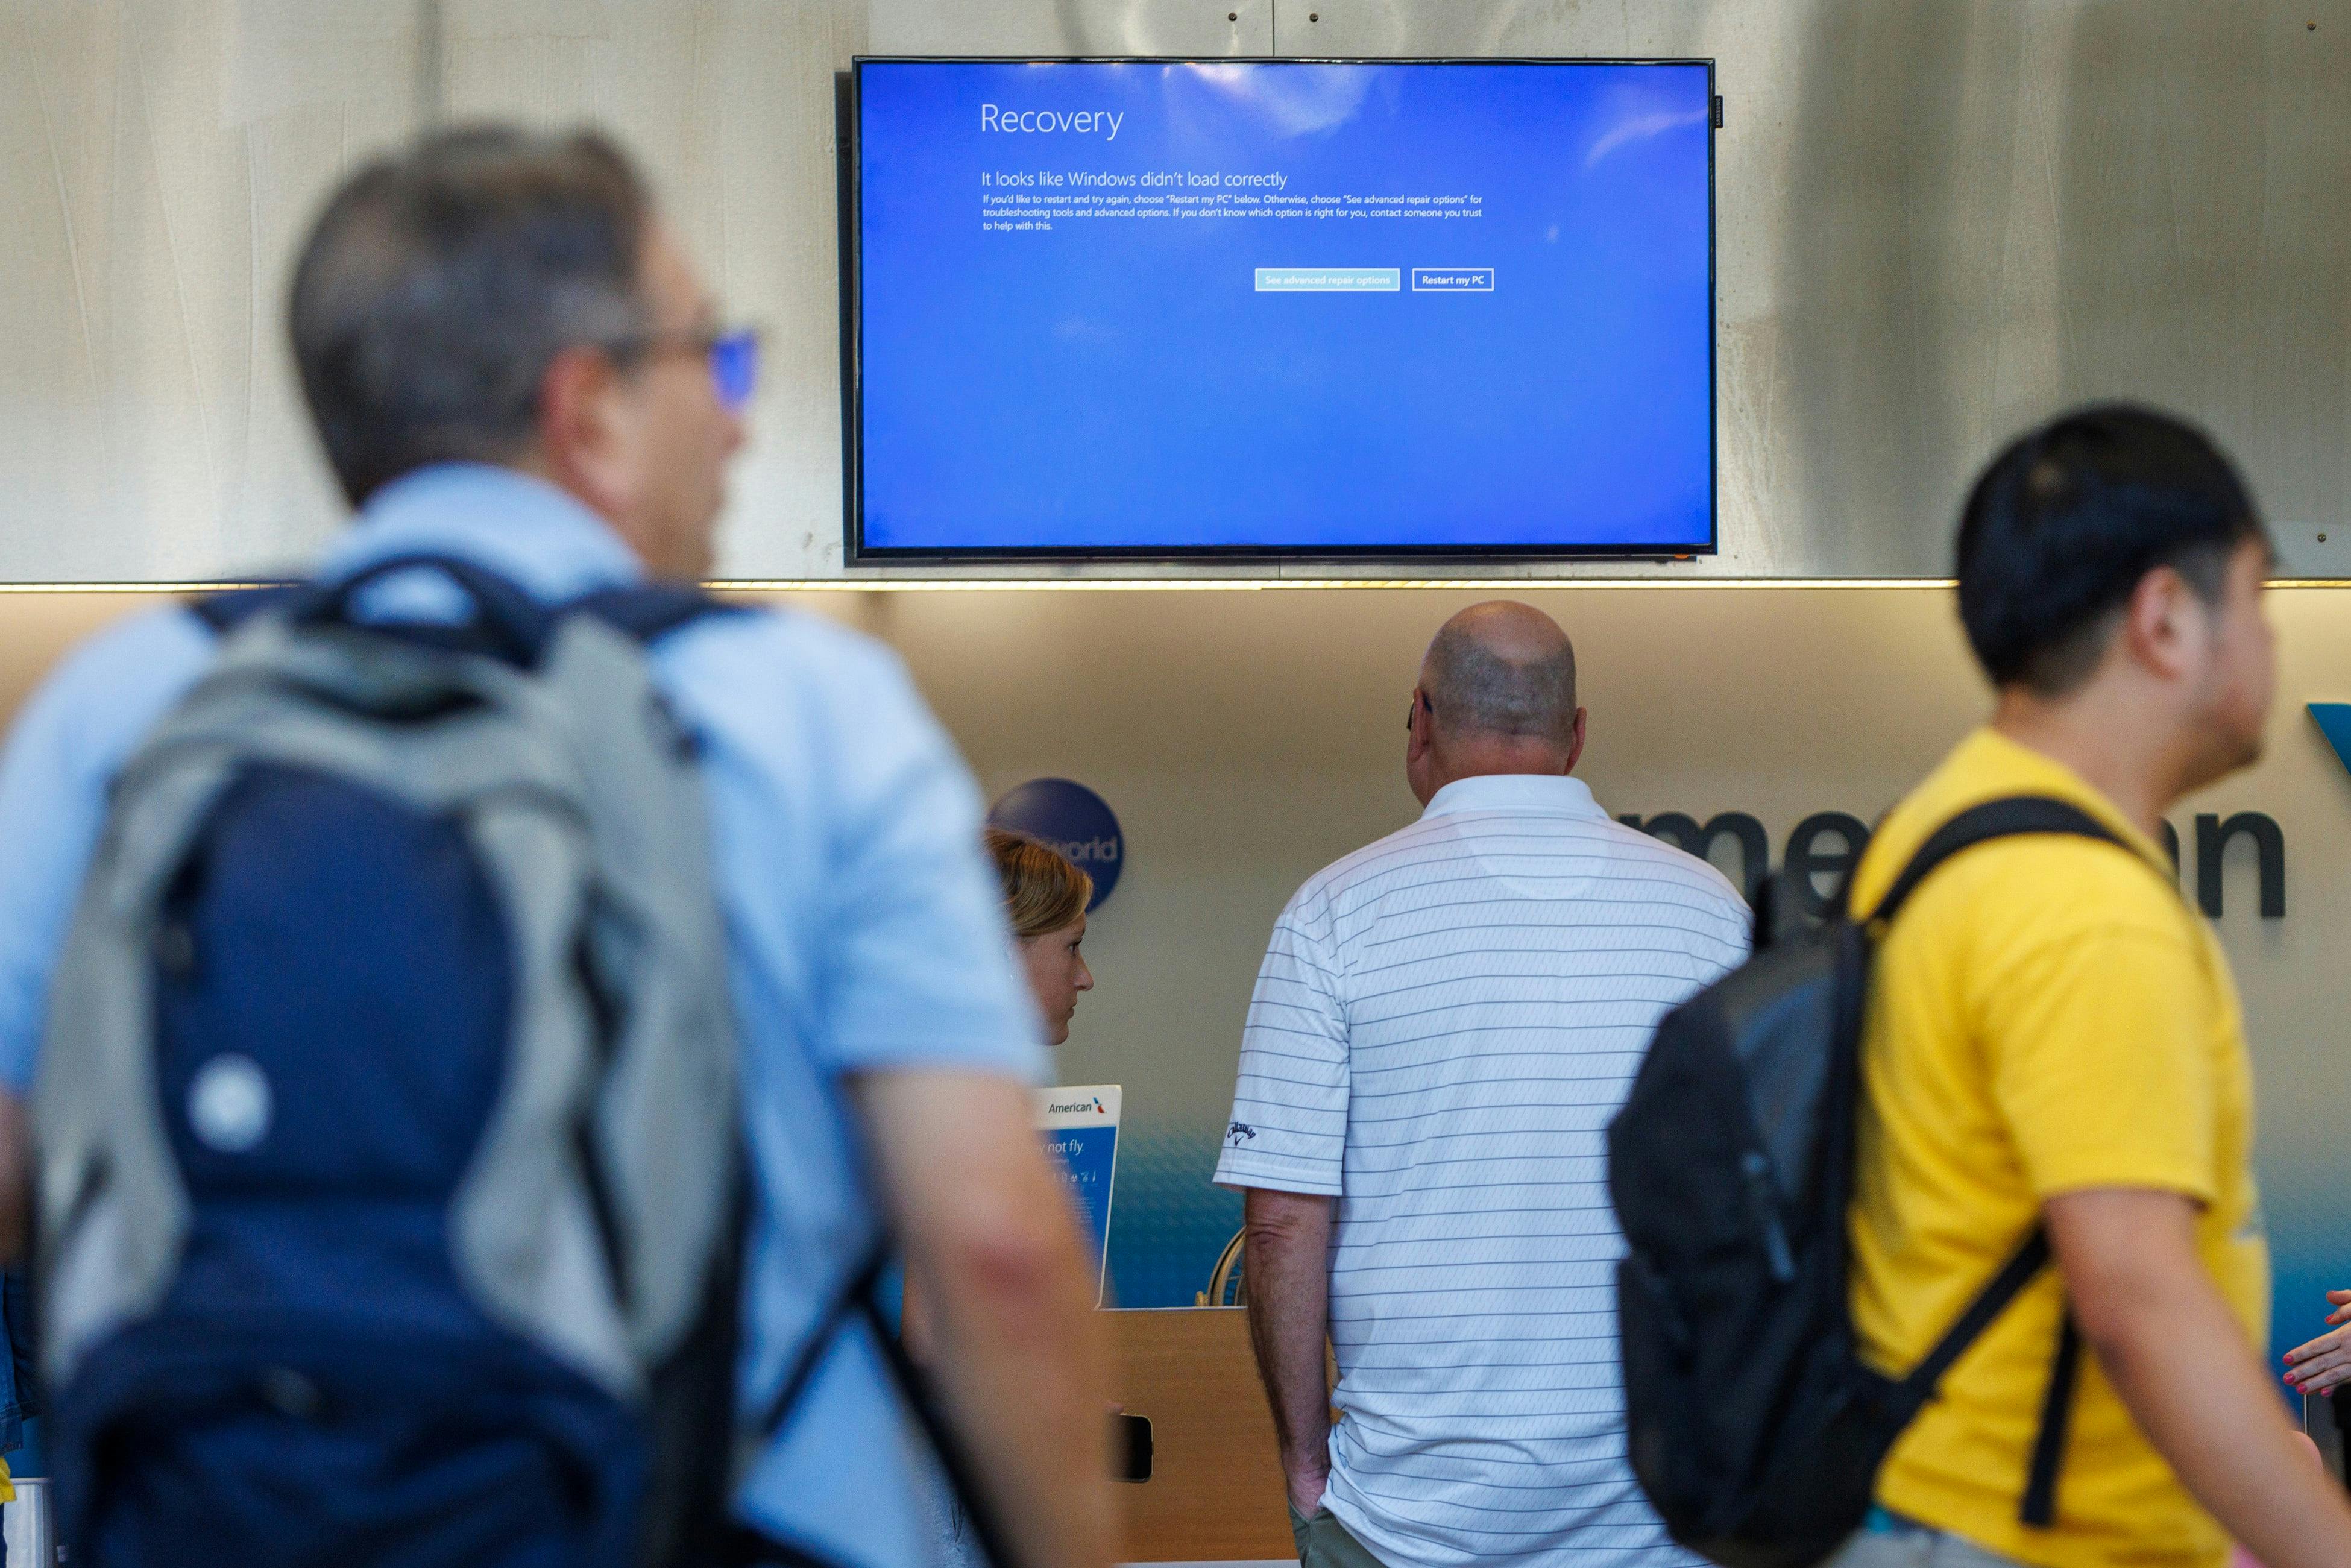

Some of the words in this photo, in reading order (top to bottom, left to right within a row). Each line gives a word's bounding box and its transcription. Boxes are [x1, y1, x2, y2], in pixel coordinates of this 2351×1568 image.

[981, 103, 1124, 142] Recovery
[981, 171, 992, 186] It
[996, 171, 1035, 187] looks
[1039, 171, 1064, 187] like
[1068, 171, 1136, 187] Windows
[1188, 171, 1220, 187] load
[1224, 171, 1288, 190] correctly
[983, 194, 990, 204] If
[1016, 194, 1031, 204] like
[1032, 195, 1042, 204] to
[1043, 195, 1072, 204] restart
[1073, 194, 1091, 204] and
[1091, 195, 1104, 206] try
[1106, 194, 1131, 206] again,
[1133, 194, 1165, 204] choose
[1201, 197, 1215, 206] my
[1234, 194, 1262, 204] below.
[1263, 194, 1309, 205] Otherwise,
[1310, 194, 1341, 204] choose
[1364, 194, 1405, 204] advanced
[1406, 195, 1431, 206] repair
[1470, 194, 1483, 204] for
[982, 207, 1051, 219] troubleshooting
[1052, 207, 1074, 218] tools
[1075, 207, 1092, 217] and
[1094, 207, 1135, 218] advanced
[1136, 208, 1171, 219] options.
[1172, 207, 1180, 217] If
[1180, 209, 1197, 219] you
[1223, 207, 1247, 218] know
[1247, 207, 1273, 218] which
[1274, 208, 1303, 219] option
[1305, 208, 1312, 218] is
[1314, 207, 1334, 219] right
[1335, 207, 1349, 218] for
[1350, 210, 1368, 219] you,
[1370, 209, 1402, 218] contact
[1403, 209, 1443, 218] someone
[1444, 210, 1461, 219] you
[1462, 209, 1482, 218] trust
[983, 222, 993, 231] to
[993, 220, 1014, 232] help
[1015, 221, 1034, 230] with
[1034, 221, 1053, 231] this.
[1265, 276, 1282, 285] See
[1283, 275, 1326, 285] advanced
[1329, 276, 1353, 286] repair
[1357, 276, 1390, 287] options
[1422, 275, 1455, 285] Restart
[1455, 277, 1471, 287] my
[1471, 275, 1485, 285] PC
[1048, 1102, 1092, 1113] American
[1048, 1141, 1066, 1153] not
